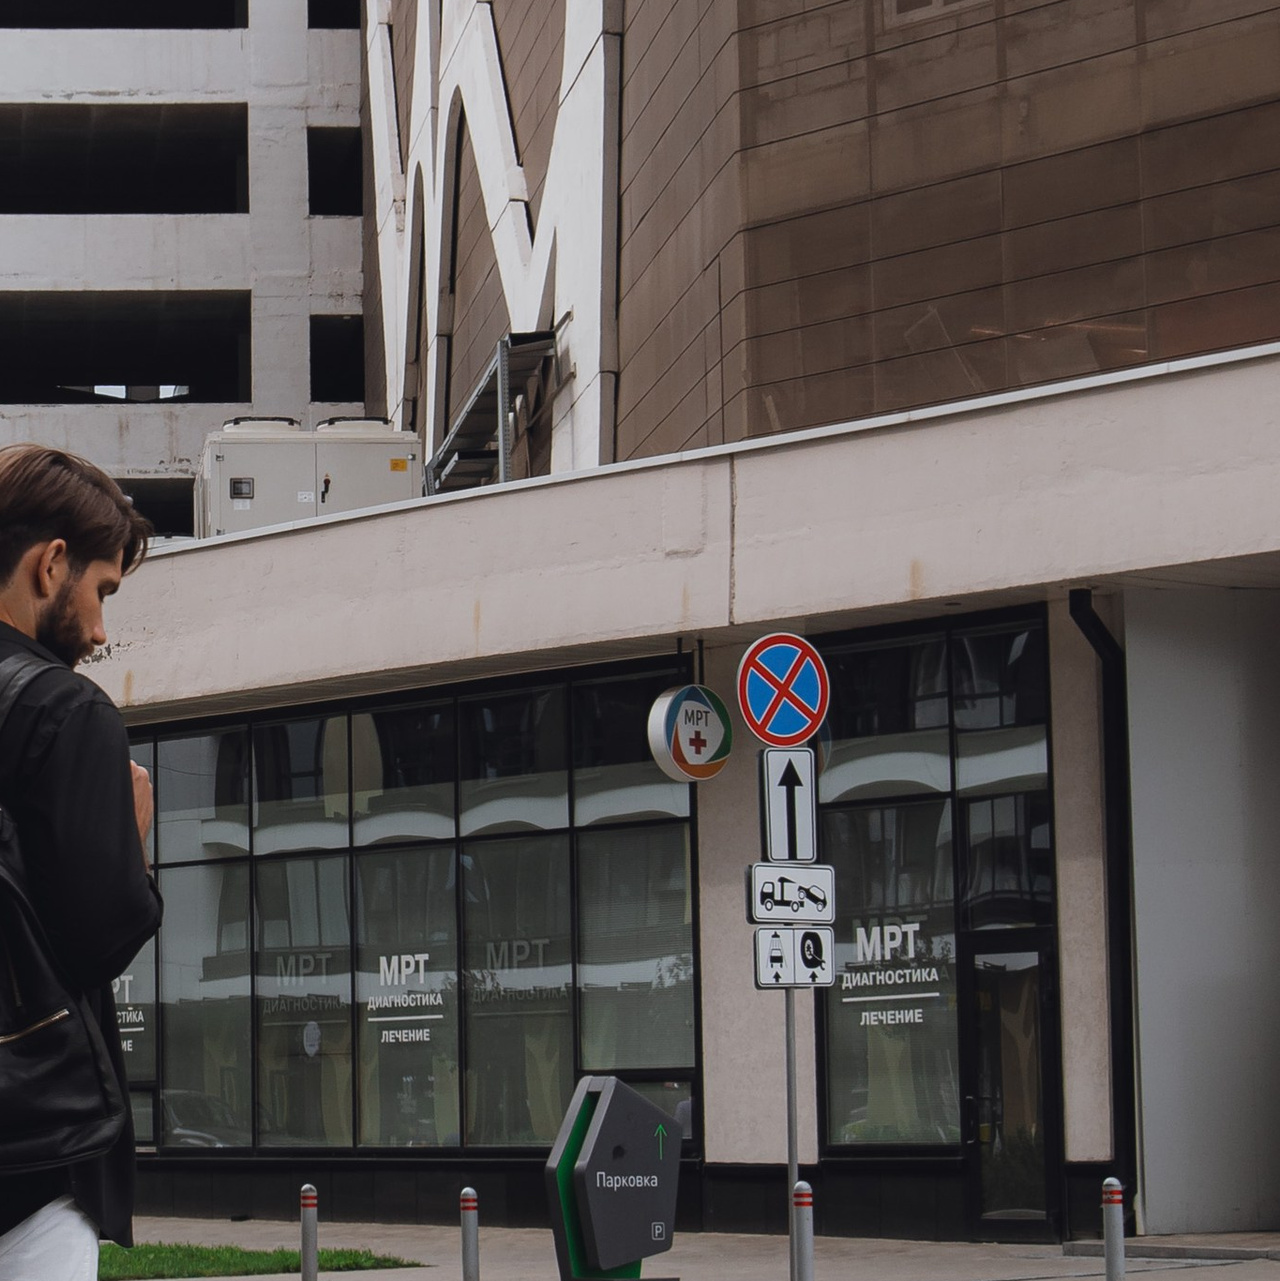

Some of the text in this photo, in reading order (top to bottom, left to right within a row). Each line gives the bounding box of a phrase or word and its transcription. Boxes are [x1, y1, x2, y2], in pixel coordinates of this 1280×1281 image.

[684, 709, 711, 727] МРТ
[856, 923, 920, 961] МРТ
[379, 953, 429, 986] МРТ
[841, 968, 939, 990] ДИАГНОСТИКА
[367, 993, 443, 1011] ДИАГНОСТИКА
[860, 1009, 923, 1025] ЛЕЧЕНИЕ
[381, 1028, 430, 1043] ЛЕЧЕНИЕ
[596, 1171, 658, 1192] Парковка
